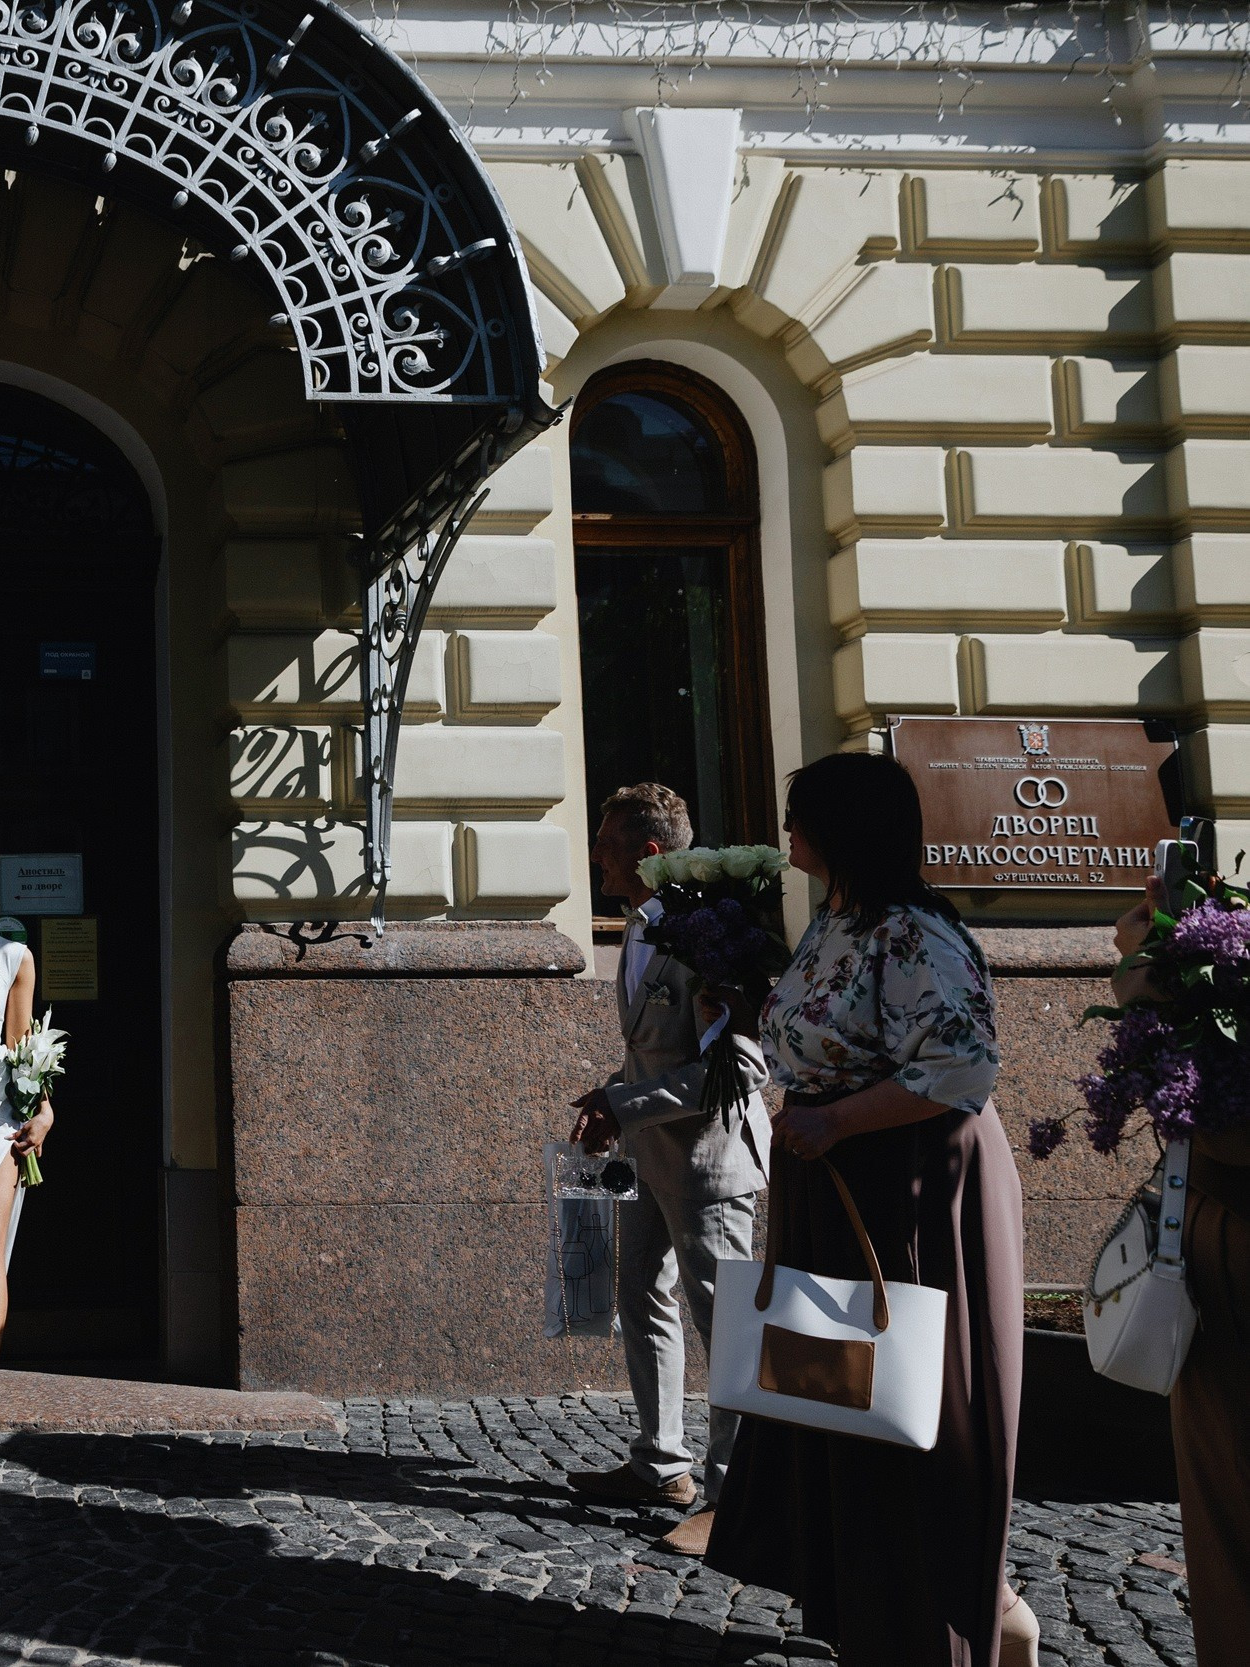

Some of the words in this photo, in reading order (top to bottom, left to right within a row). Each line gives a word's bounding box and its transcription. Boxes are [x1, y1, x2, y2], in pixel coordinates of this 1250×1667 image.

[992, 815, 1100, 839] ДВОРЕЦ
[924, 845, 1155, 868] БРАКОСОЧЕТАНИ
[18, 867, 66, 877] Апостиль
[1089, 871, 1105, 882] 52
[35, 883, 63, 892] дворе
